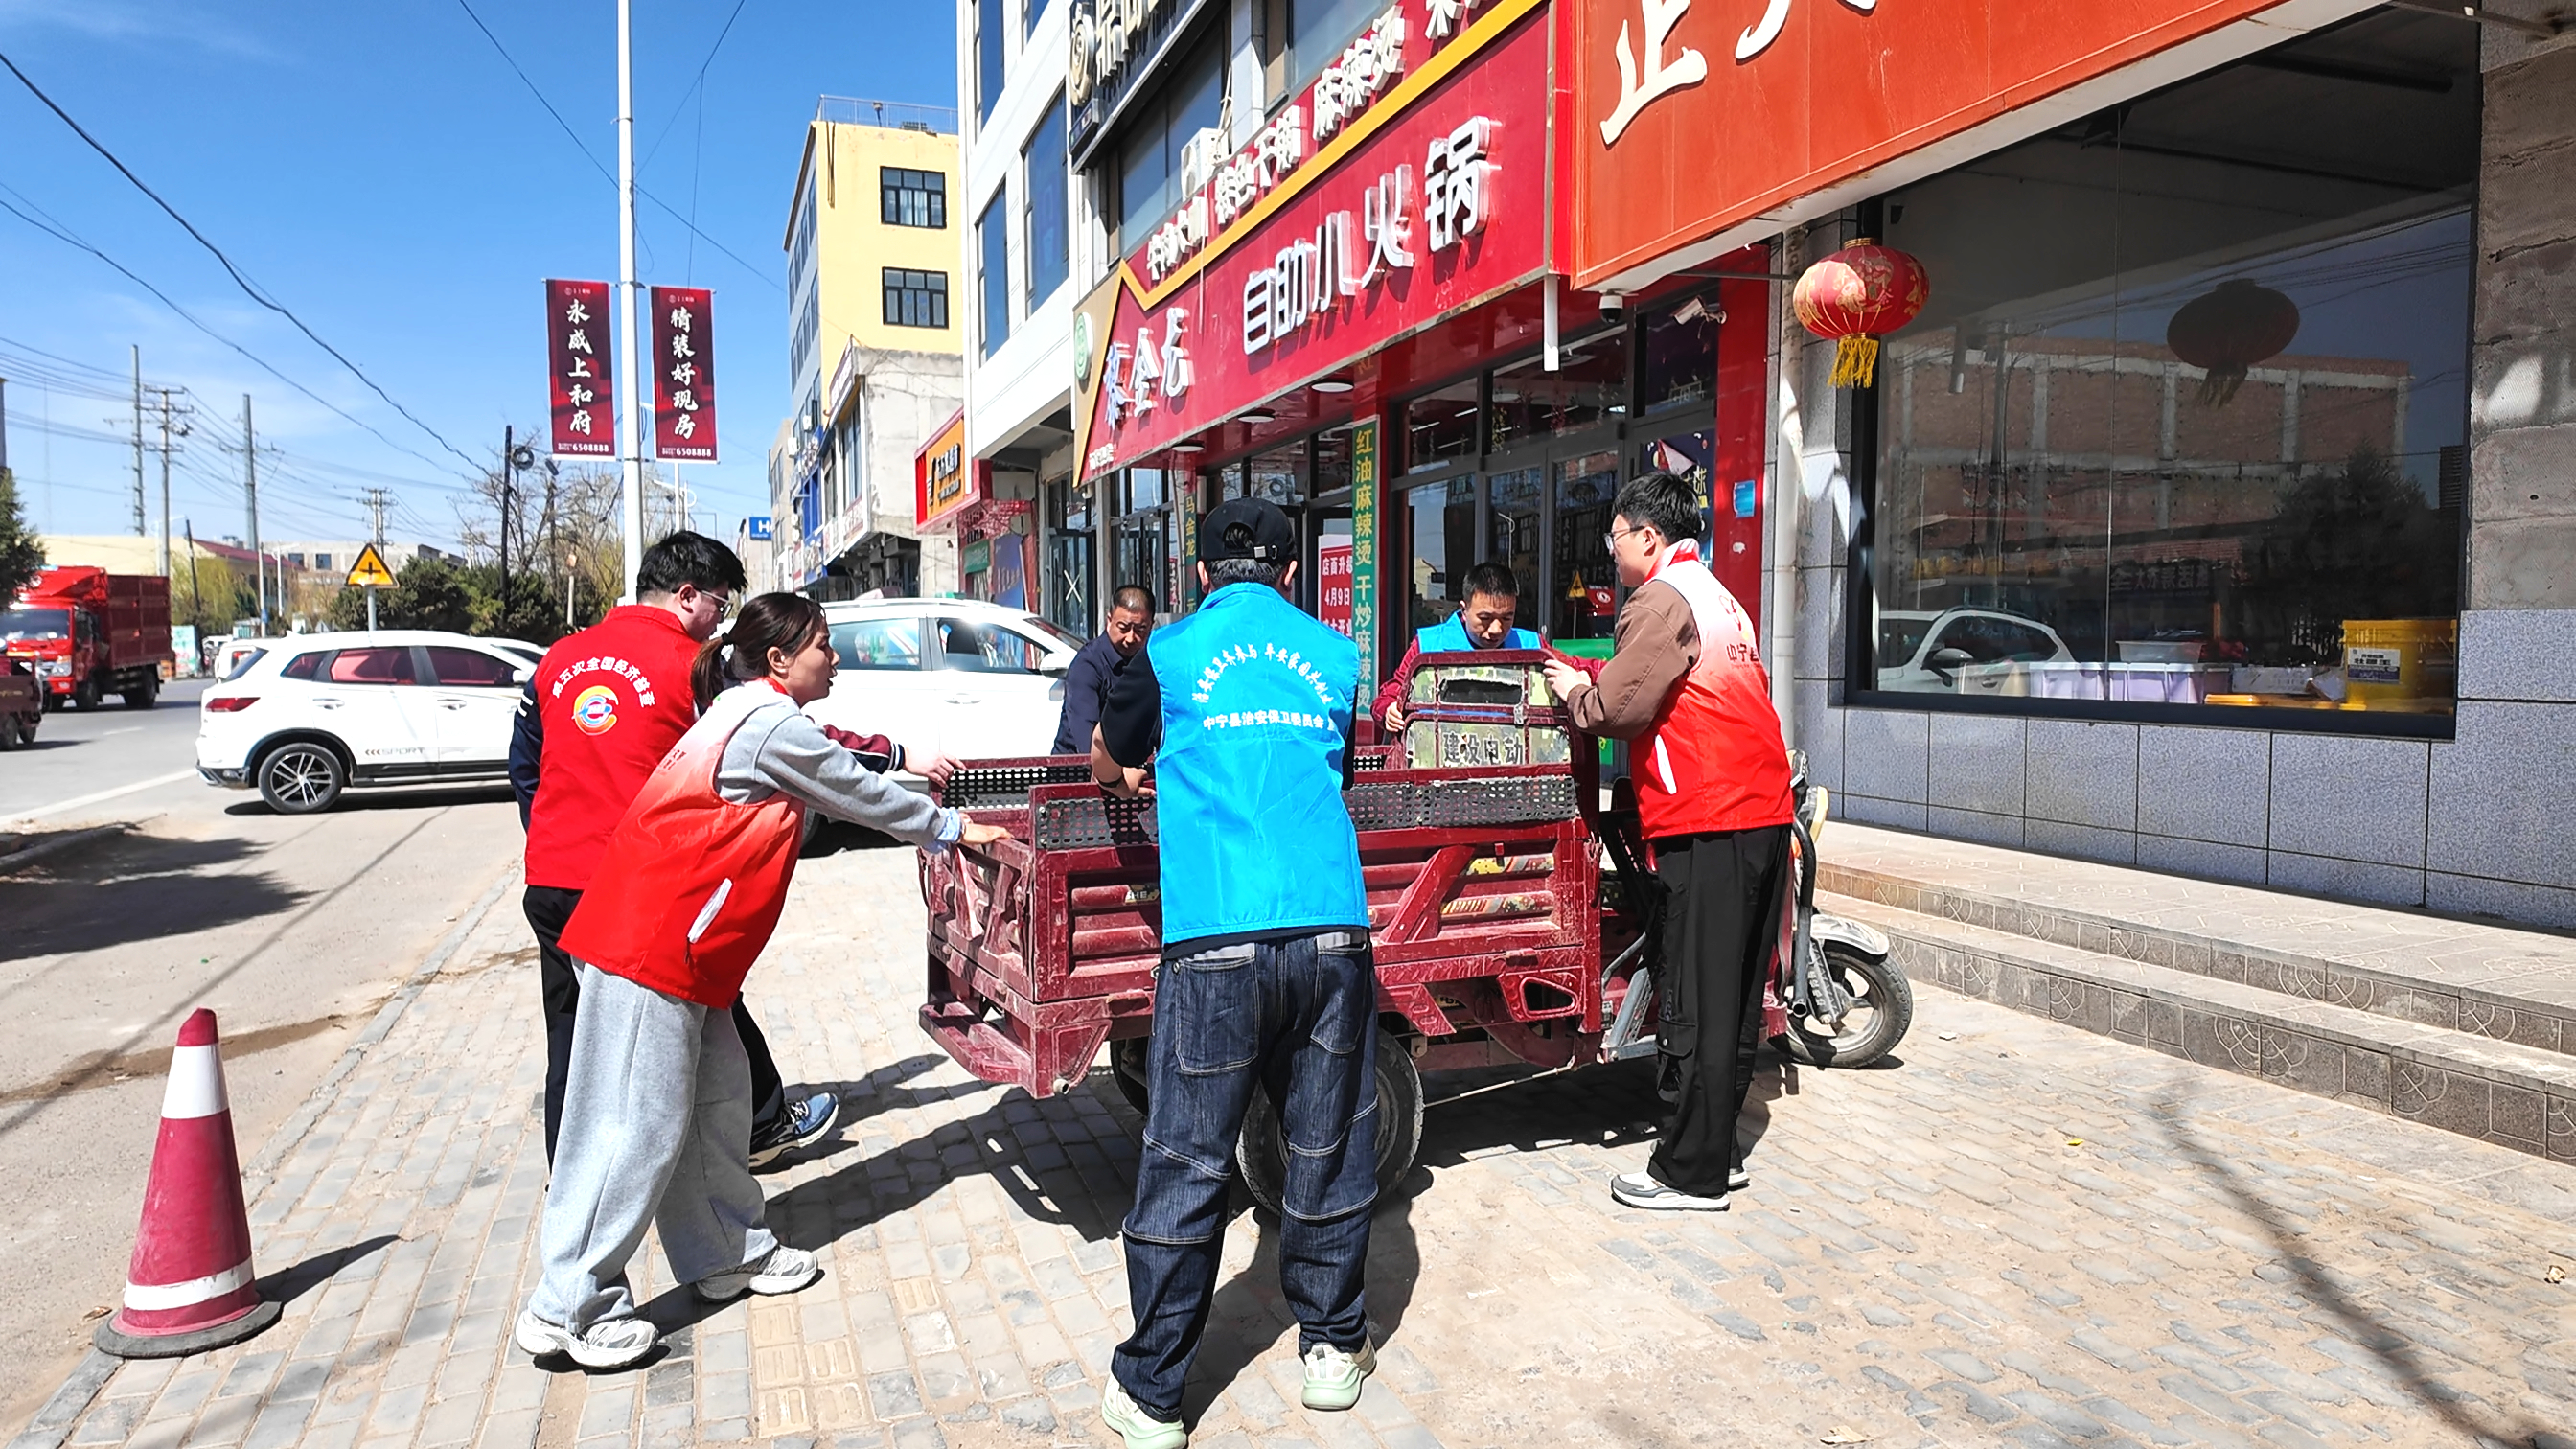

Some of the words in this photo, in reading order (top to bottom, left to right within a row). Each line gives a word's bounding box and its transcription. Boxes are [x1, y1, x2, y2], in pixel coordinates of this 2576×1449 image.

[1243, 116, 1490, 356] 自助小火锅
[671, 306, 699, 440] 精装好现房
[1354, 429, 1374, 565] 红油麻辣烫
[1185, 496, 1196, 556] 马金龙
[1324, 587, 1350, 607] 4月9日
[552, 656, 656, 708] 第五次全国经济普查
[1203, 708, 1324, 731] 中宁县治安保卫委员会
[1443, 732, 1524, 766] 建设电动
